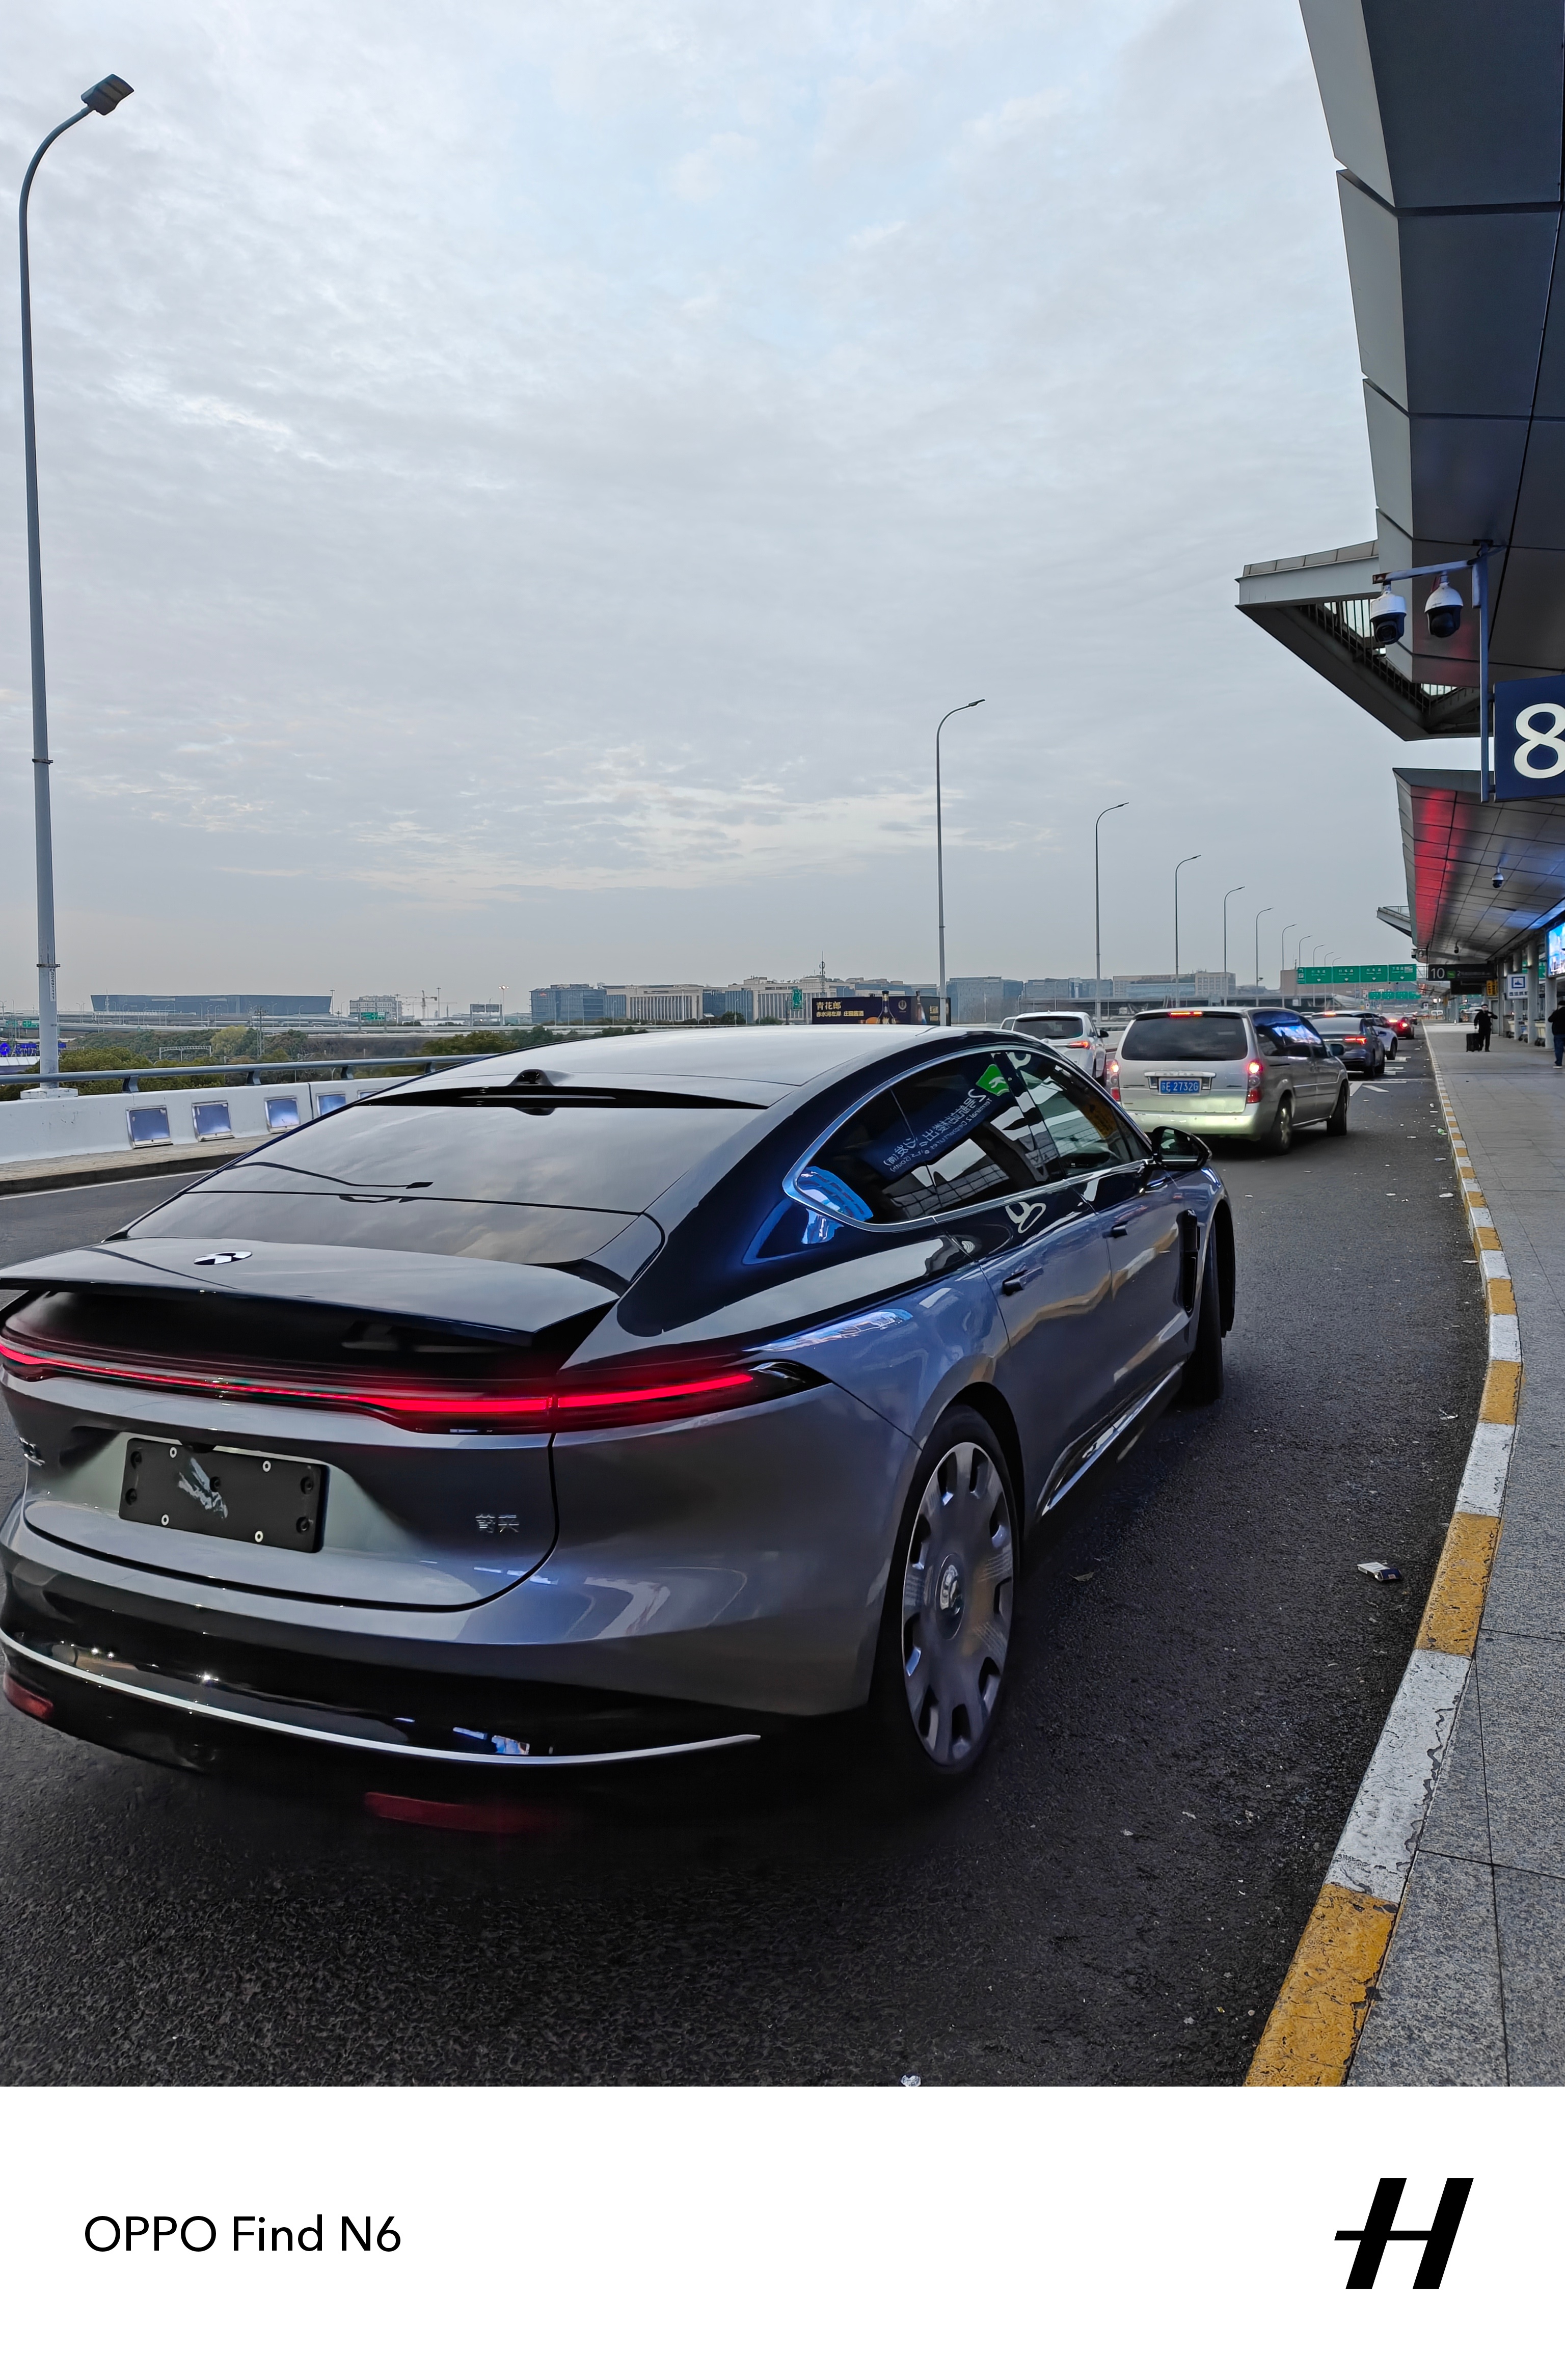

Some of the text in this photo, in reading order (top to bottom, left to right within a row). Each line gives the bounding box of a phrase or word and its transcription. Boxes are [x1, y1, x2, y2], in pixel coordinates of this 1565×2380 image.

[1514, 704, 1565, 778] 8
[1431, 968, 1445, 979] 10
[816, 1001, 842, 1010] 青花郎
